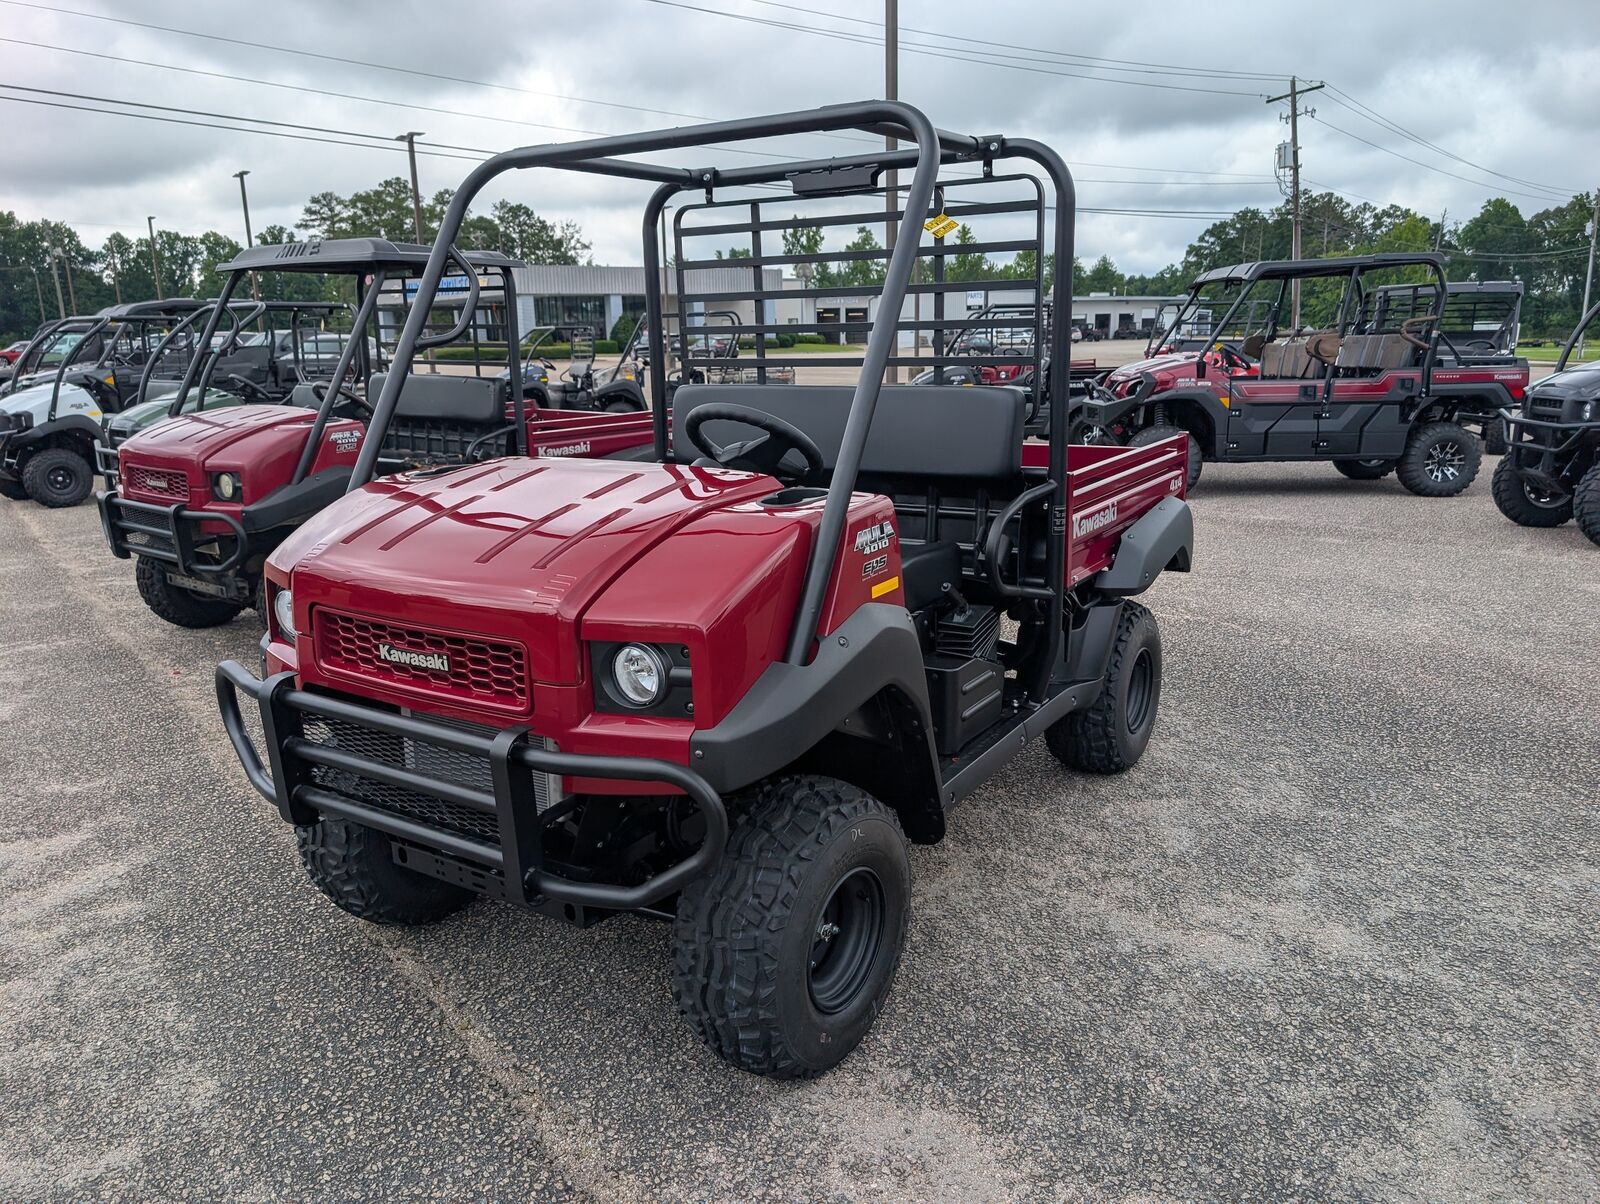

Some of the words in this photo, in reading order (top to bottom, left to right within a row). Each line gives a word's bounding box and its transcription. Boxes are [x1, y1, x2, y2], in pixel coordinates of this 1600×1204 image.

[537, 441, 591, 457] Kawasaki
[146, 479, 168, 488] Kawasaki
[1072, 500, 1118, 540] Kawasaki
[854, 521, 896, 552] MULE
[864, 539, 889, 556] 4010
[862, 554, 888, 576] EPS
[378, 643, 449, 672] Kawasaki
